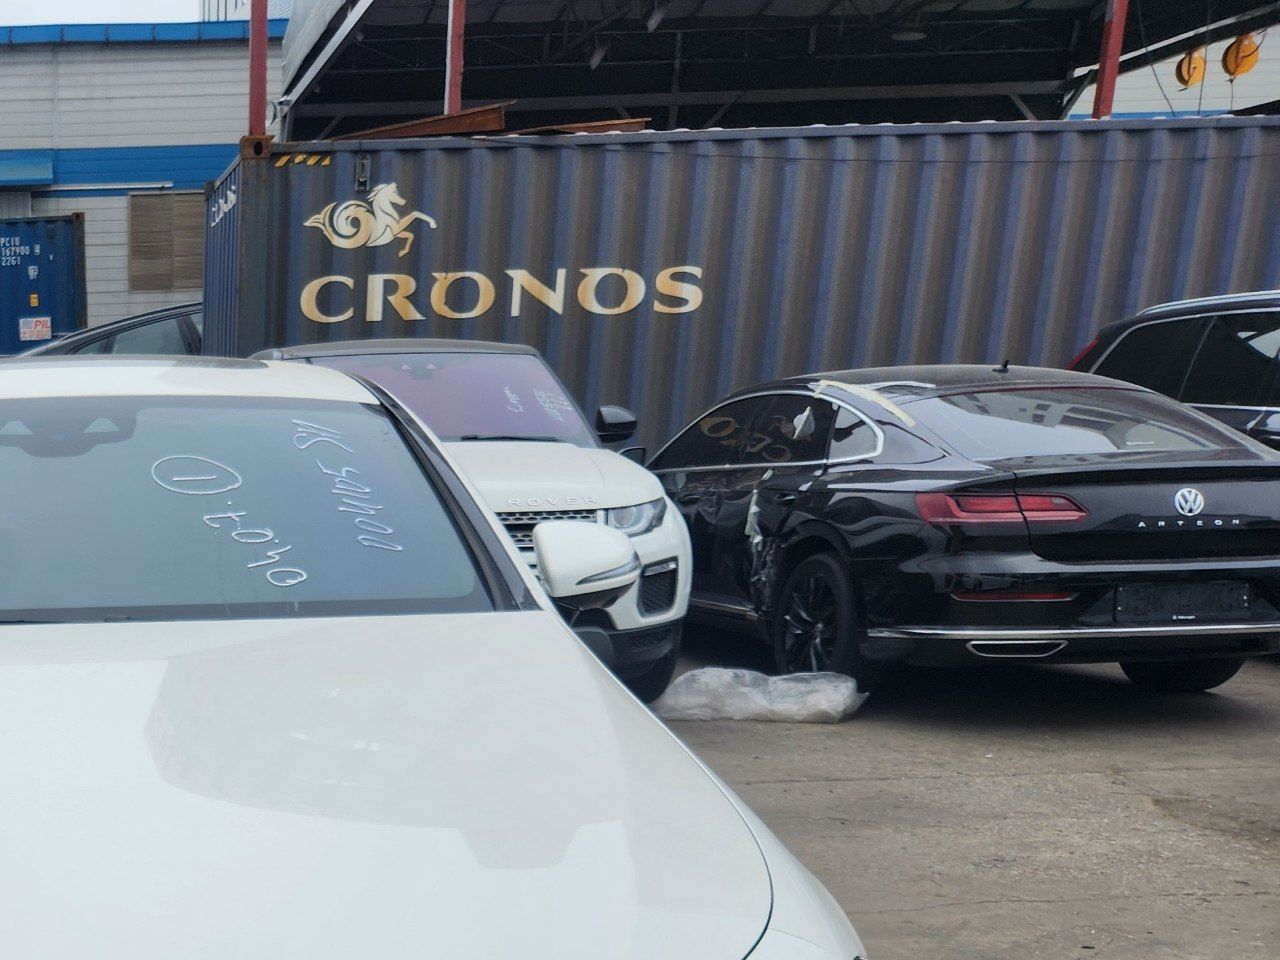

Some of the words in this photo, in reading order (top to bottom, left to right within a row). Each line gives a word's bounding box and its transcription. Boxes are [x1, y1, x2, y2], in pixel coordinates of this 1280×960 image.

[300, 265, 703, 323] CRONOS
[507, 496, 600, 507] ROVER
[1138, 519, 1240, 528] ARTEON
